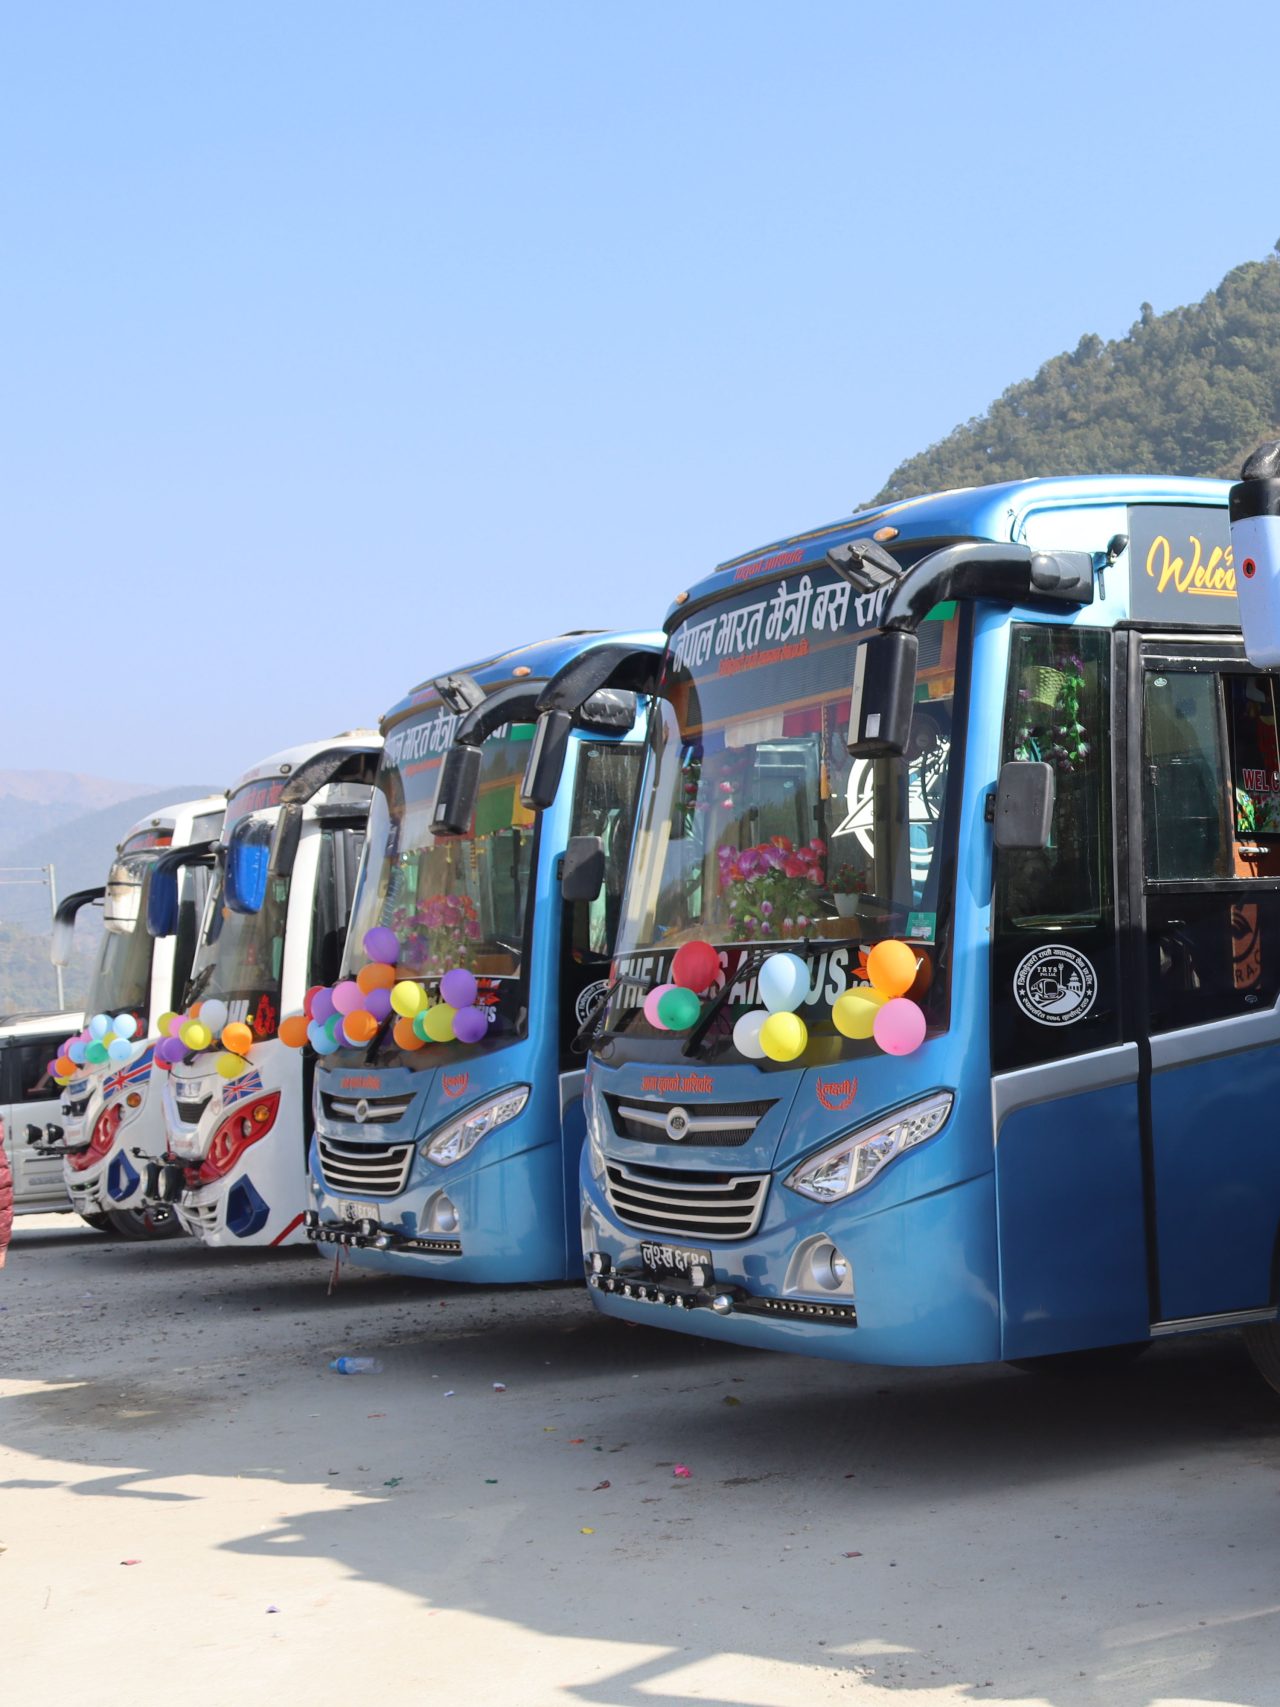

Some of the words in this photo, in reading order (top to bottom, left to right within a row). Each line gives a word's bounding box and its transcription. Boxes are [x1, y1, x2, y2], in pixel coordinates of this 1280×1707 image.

[672, 617, 718, 674] नेपाल
[715, 603, 767, 656] भारत
[765, 575, 813, 642] मैत्री
[812, 581, 852, 633] बस
